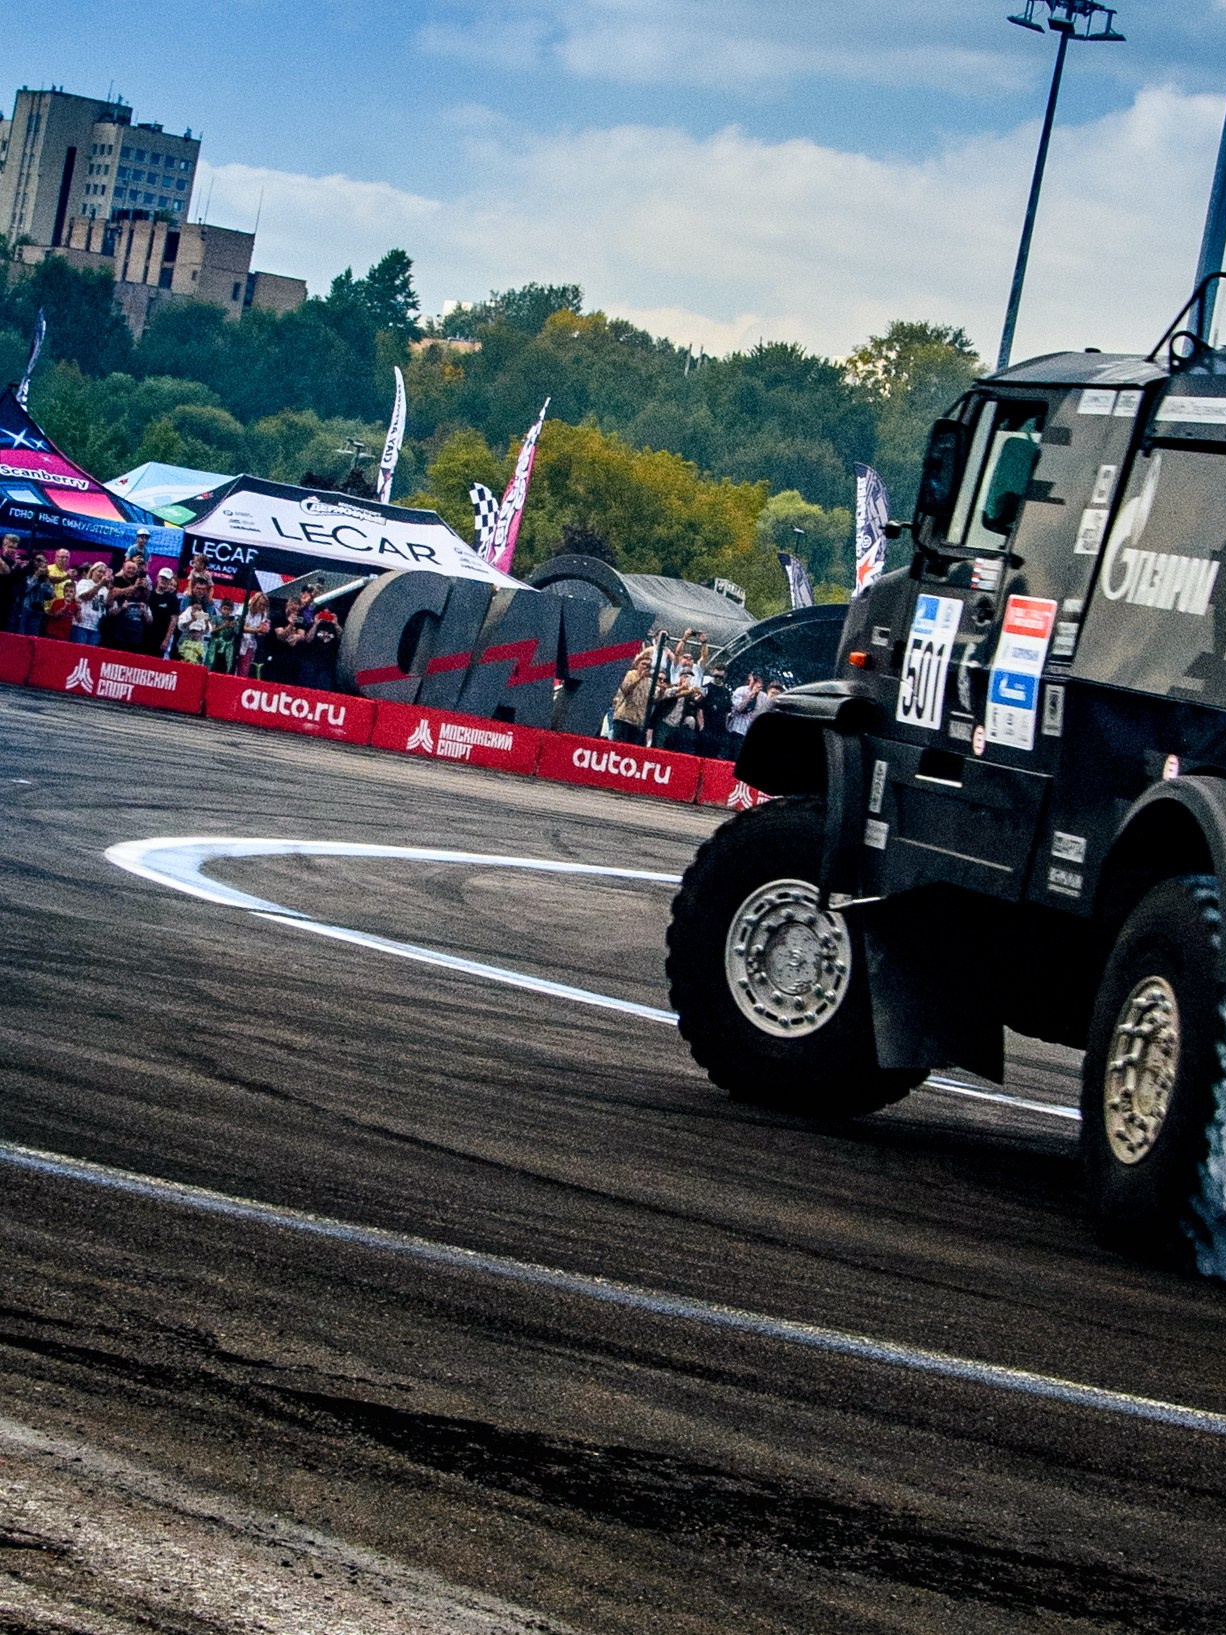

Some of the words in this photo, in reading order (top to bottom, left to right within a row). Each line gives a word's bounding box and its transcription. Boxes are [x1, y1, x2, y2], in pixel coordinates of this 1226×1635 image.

[0, 464, 88, 490] Scanberry
[9, 507, 59, 525] ГОНОНЫЕ
[270, 516, 443, 566] LECAR
[96, 678, 135, 701] СПОРТ
[100, 661, 178, 691] МОСКОВСКИЙ
[901, 638, 946, 722] 501
[240, 687, 347, 727] auto.ru
[436, 738, 474, 761] СПОРТ
[439, 722, 514, 752] МОСКОВСКИЙ
[572, 747, 672, 785] auto.ru
